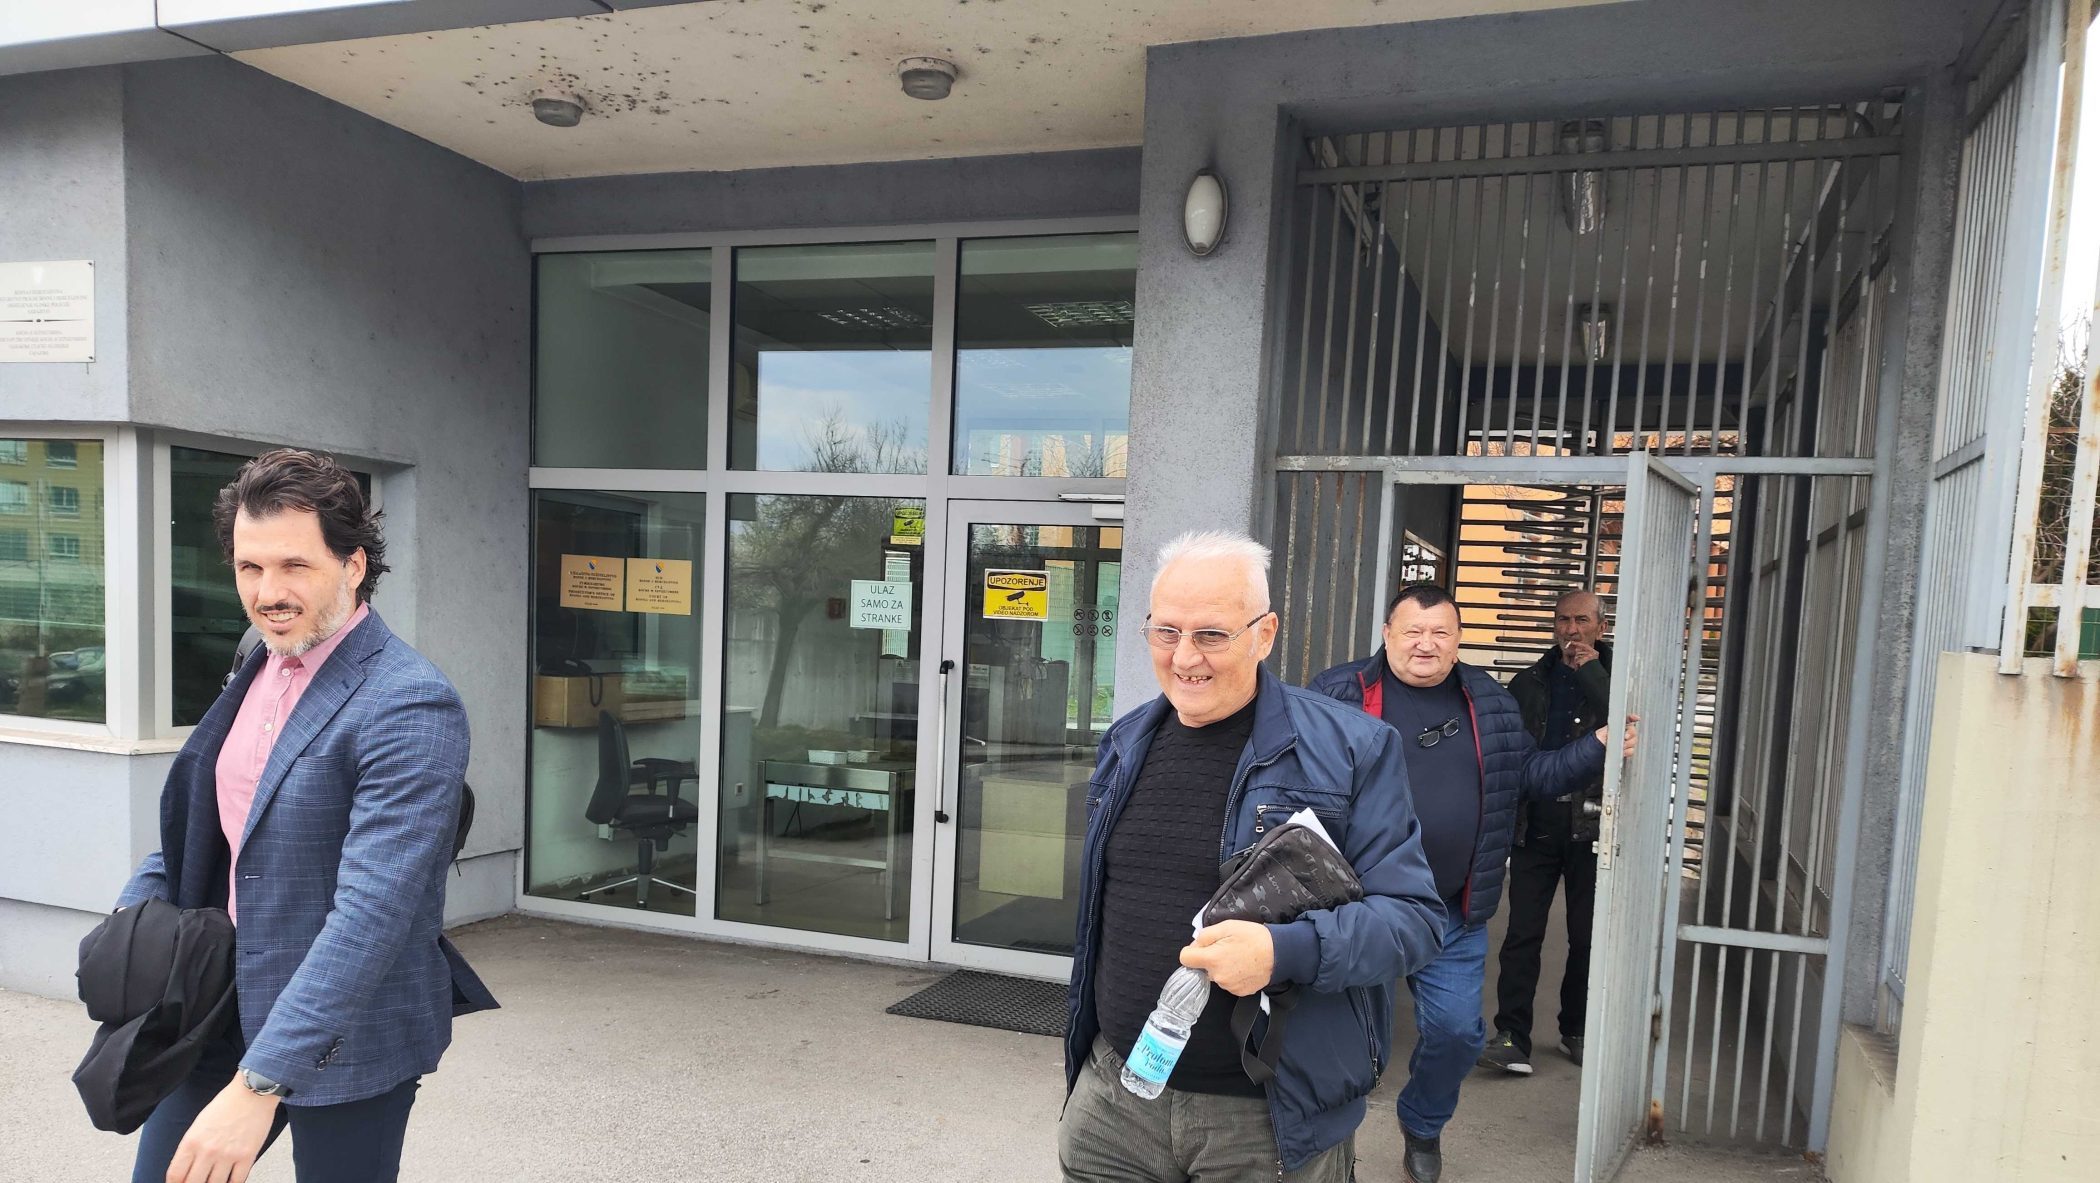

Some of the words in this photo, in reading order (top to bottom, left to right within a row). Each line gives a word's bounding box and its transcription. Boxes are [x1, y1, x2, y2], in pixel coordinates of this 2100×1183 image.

[990, 577, 1045, 587] UPOZORENJE
[870, 584, 895, 595] ULAZ
[860, 598, 889, 609] SAMO
[890, 600, 904, 610] ZA
[860, 612, 903, 624] STRANKE
[1141, 1044, 1174, 1067] Prolom
